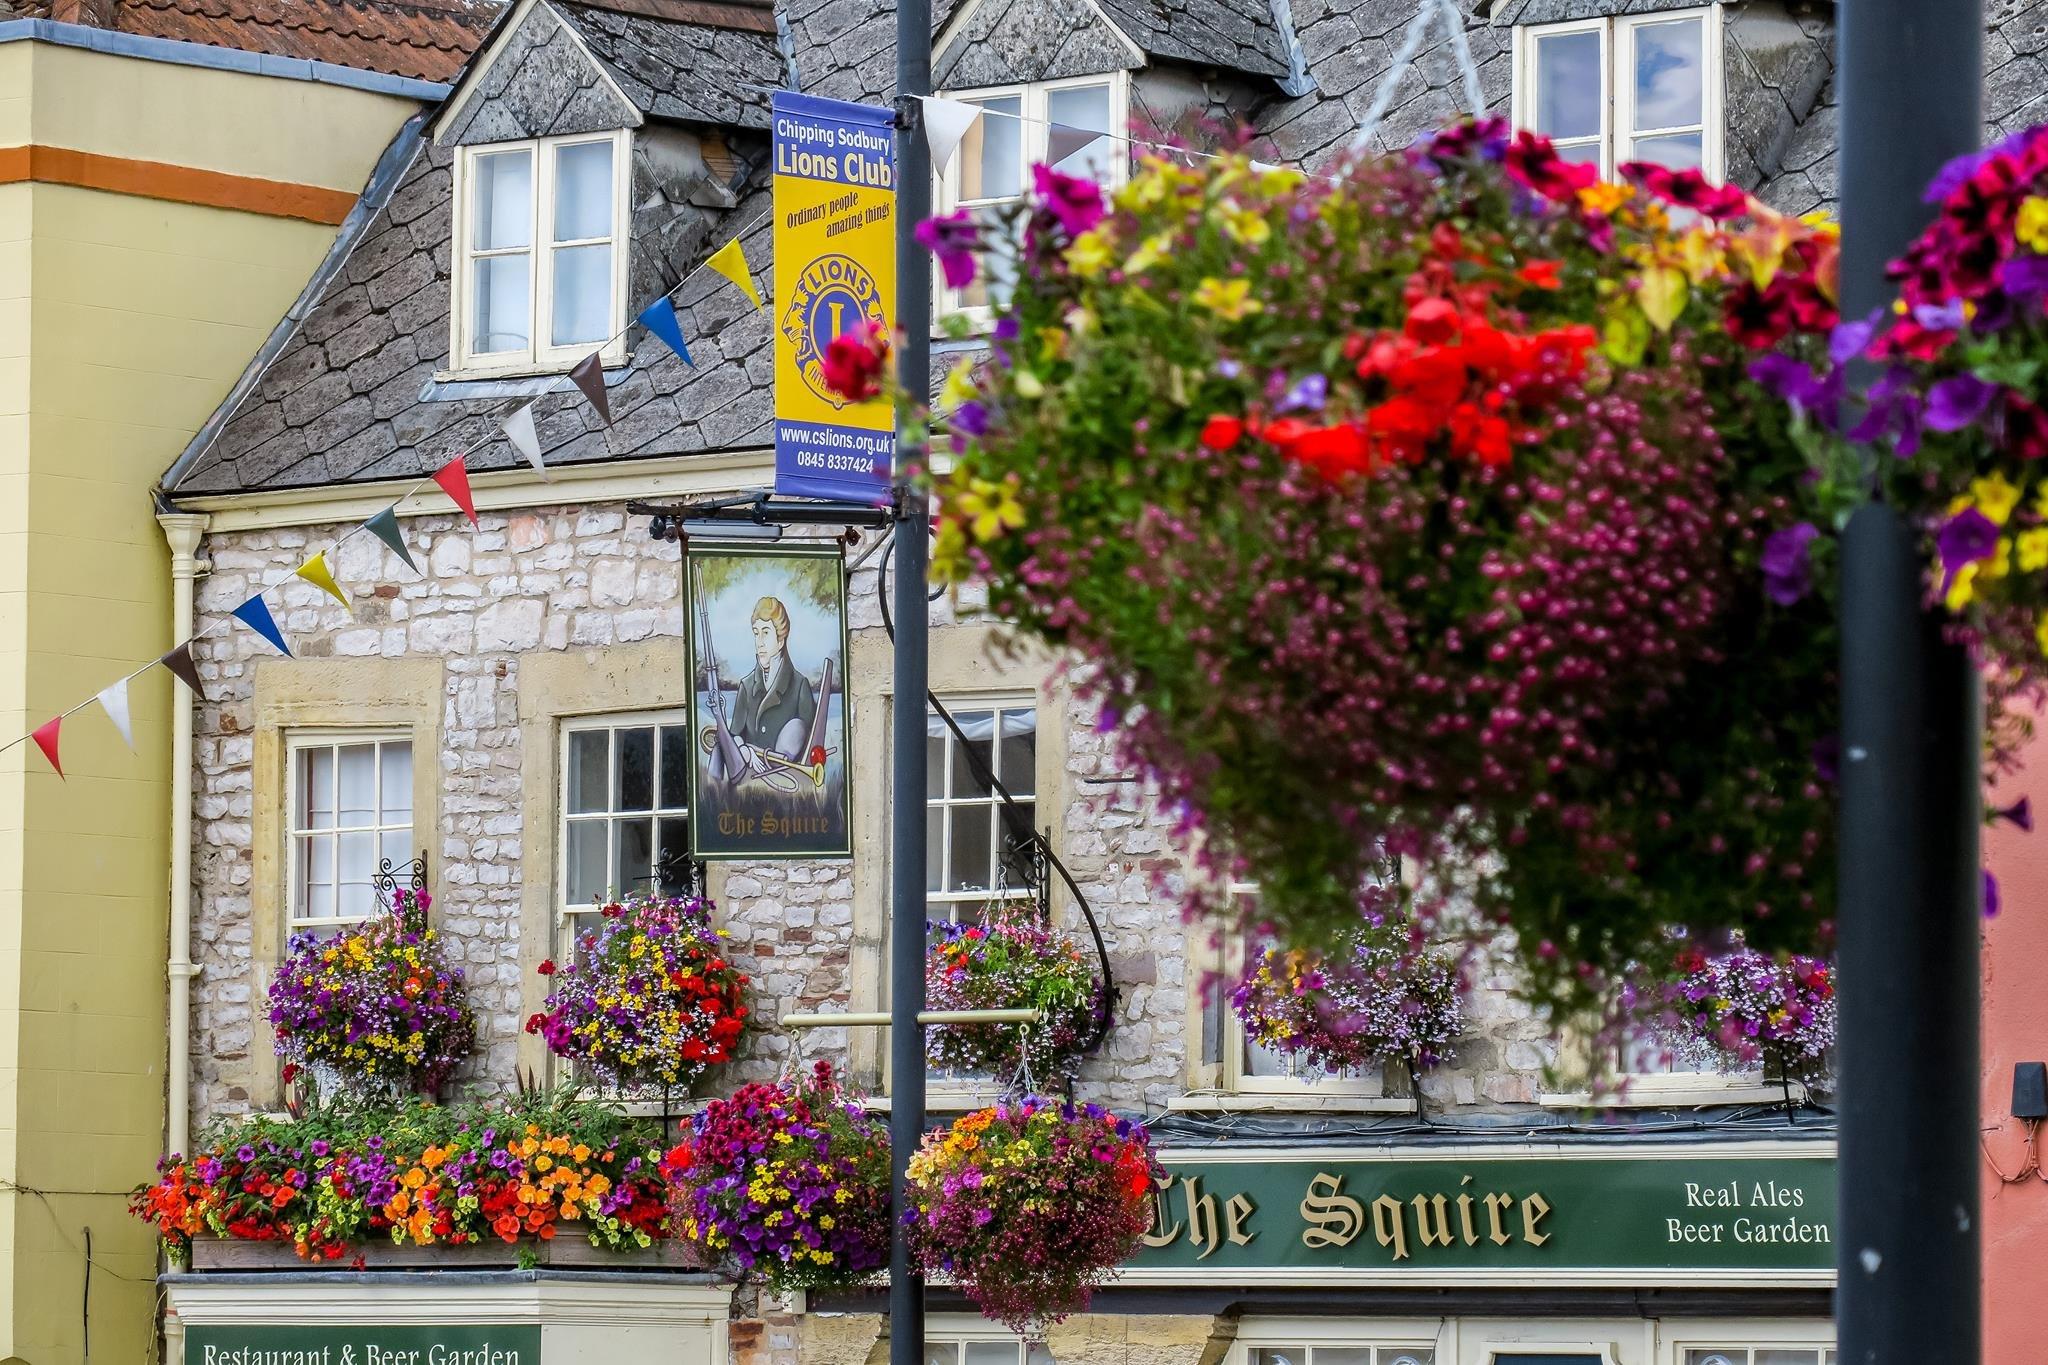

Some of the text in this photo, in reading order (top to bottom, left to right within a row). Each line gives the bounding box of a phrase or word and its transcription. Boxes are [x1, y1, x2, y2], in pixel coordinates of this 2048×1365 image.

[777, 118, 890, 156] Chipping Sodbury
[778, 143, 892, 187] Lions Club
[787, 191, 859, 229] Ordinary people
[826, 202, 890, 238] amazing things
[807, 260, 870, 296] LIONS
[780, 427, 890, 456] www.cslions.org.uk
[797, 450, 874, 474] 0845 8337424
[717, 809, 829, 839] The Squire
[1684, 1180, 1804, 1207] Real Ales
[1300, 1171, 1552, 1261] Squire
[1666, 1216, 1831, 1243] Beer Garden
[203, 1342, 519, 1365] Restaurant & Beer Garden
